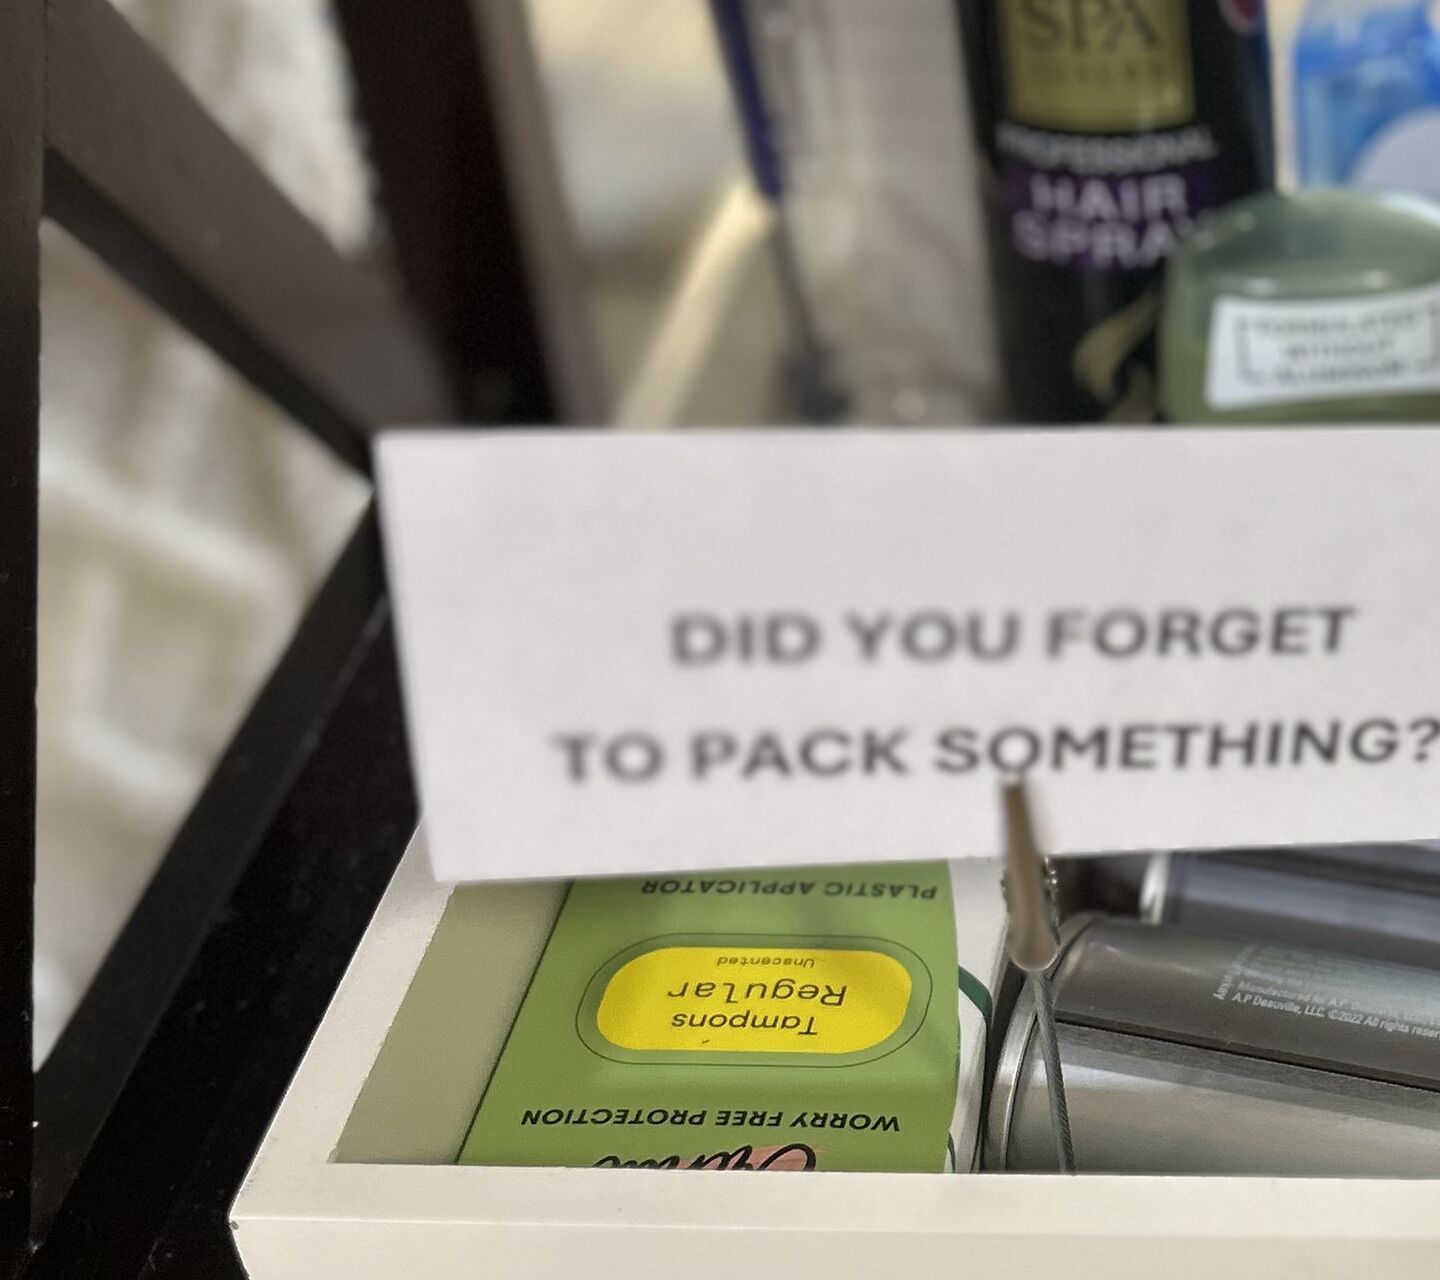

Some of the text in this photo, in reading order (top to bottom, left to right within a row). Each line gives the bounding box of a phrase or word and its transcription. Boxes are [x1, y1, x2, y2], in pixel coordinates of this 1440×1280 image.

[1029, 172, 1190, 222] HAIR
[668, 605, 1357, 668] DID YOU FORGET
[550, 729, 666, 787] TO
[688, 727, 911, 782] PACK
[640, 878, 938, 901] PLASTIC APPLICATOR
[716, 956, 815, 969] Unscented
[667, 978, 847, 1007] Regular
[671, 1010, 818, 1036] Tampons
[1362, 1014, 1380, 1028] All
[1378, 1017, 1411, 1036] rights
[520, 1107, 900, 1133] WORRY FREE PROTECTION
